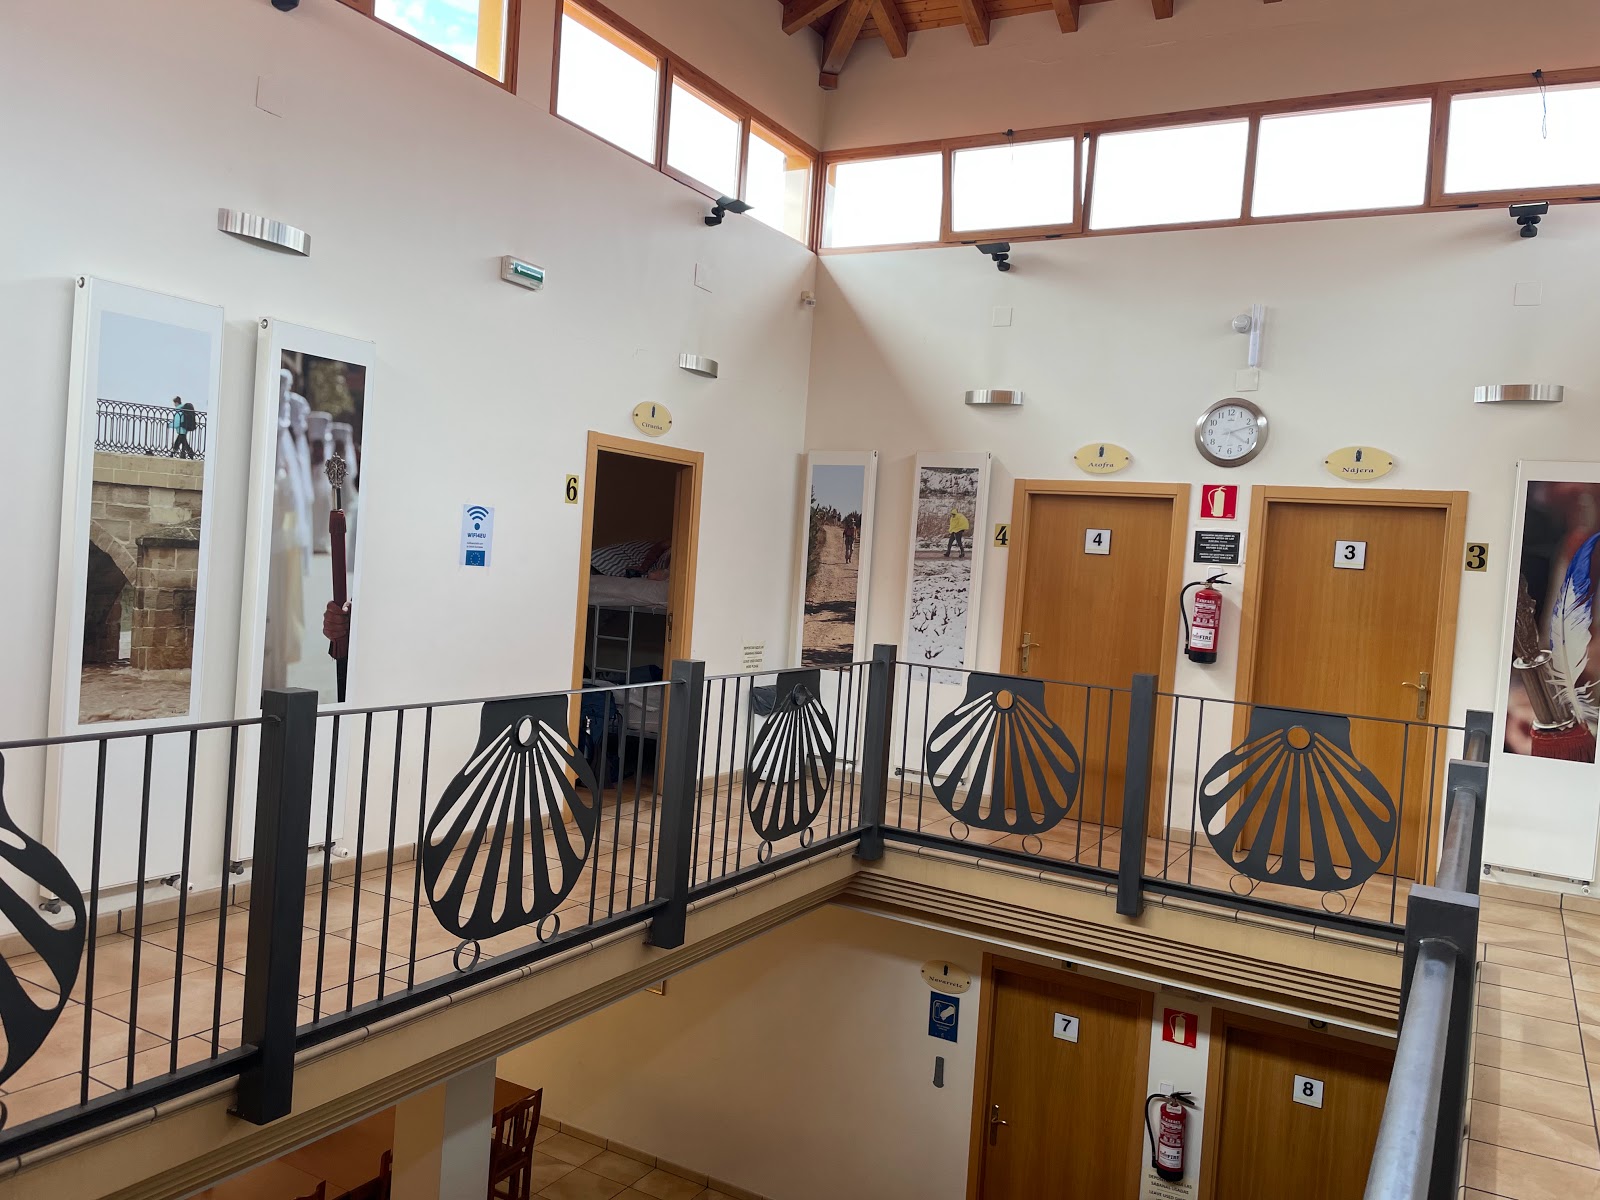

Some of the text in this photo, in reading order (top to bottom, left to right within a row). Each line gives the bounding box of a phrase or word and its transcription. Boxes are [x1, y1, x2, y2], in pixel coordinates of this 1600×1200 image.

[1227, 408, 1236, 416] 12
[566, 477, 577, 501] 6
[995, 525, 1008, 546] 4
[1092, 532, 1103, 546] 4
[1343, 545, 1356, 560] 3
[1466, 545, 1486, 569] 3
[1061, 1018, 1072, 1032] 7
[1302, 1081, 1314, 1097] 8
